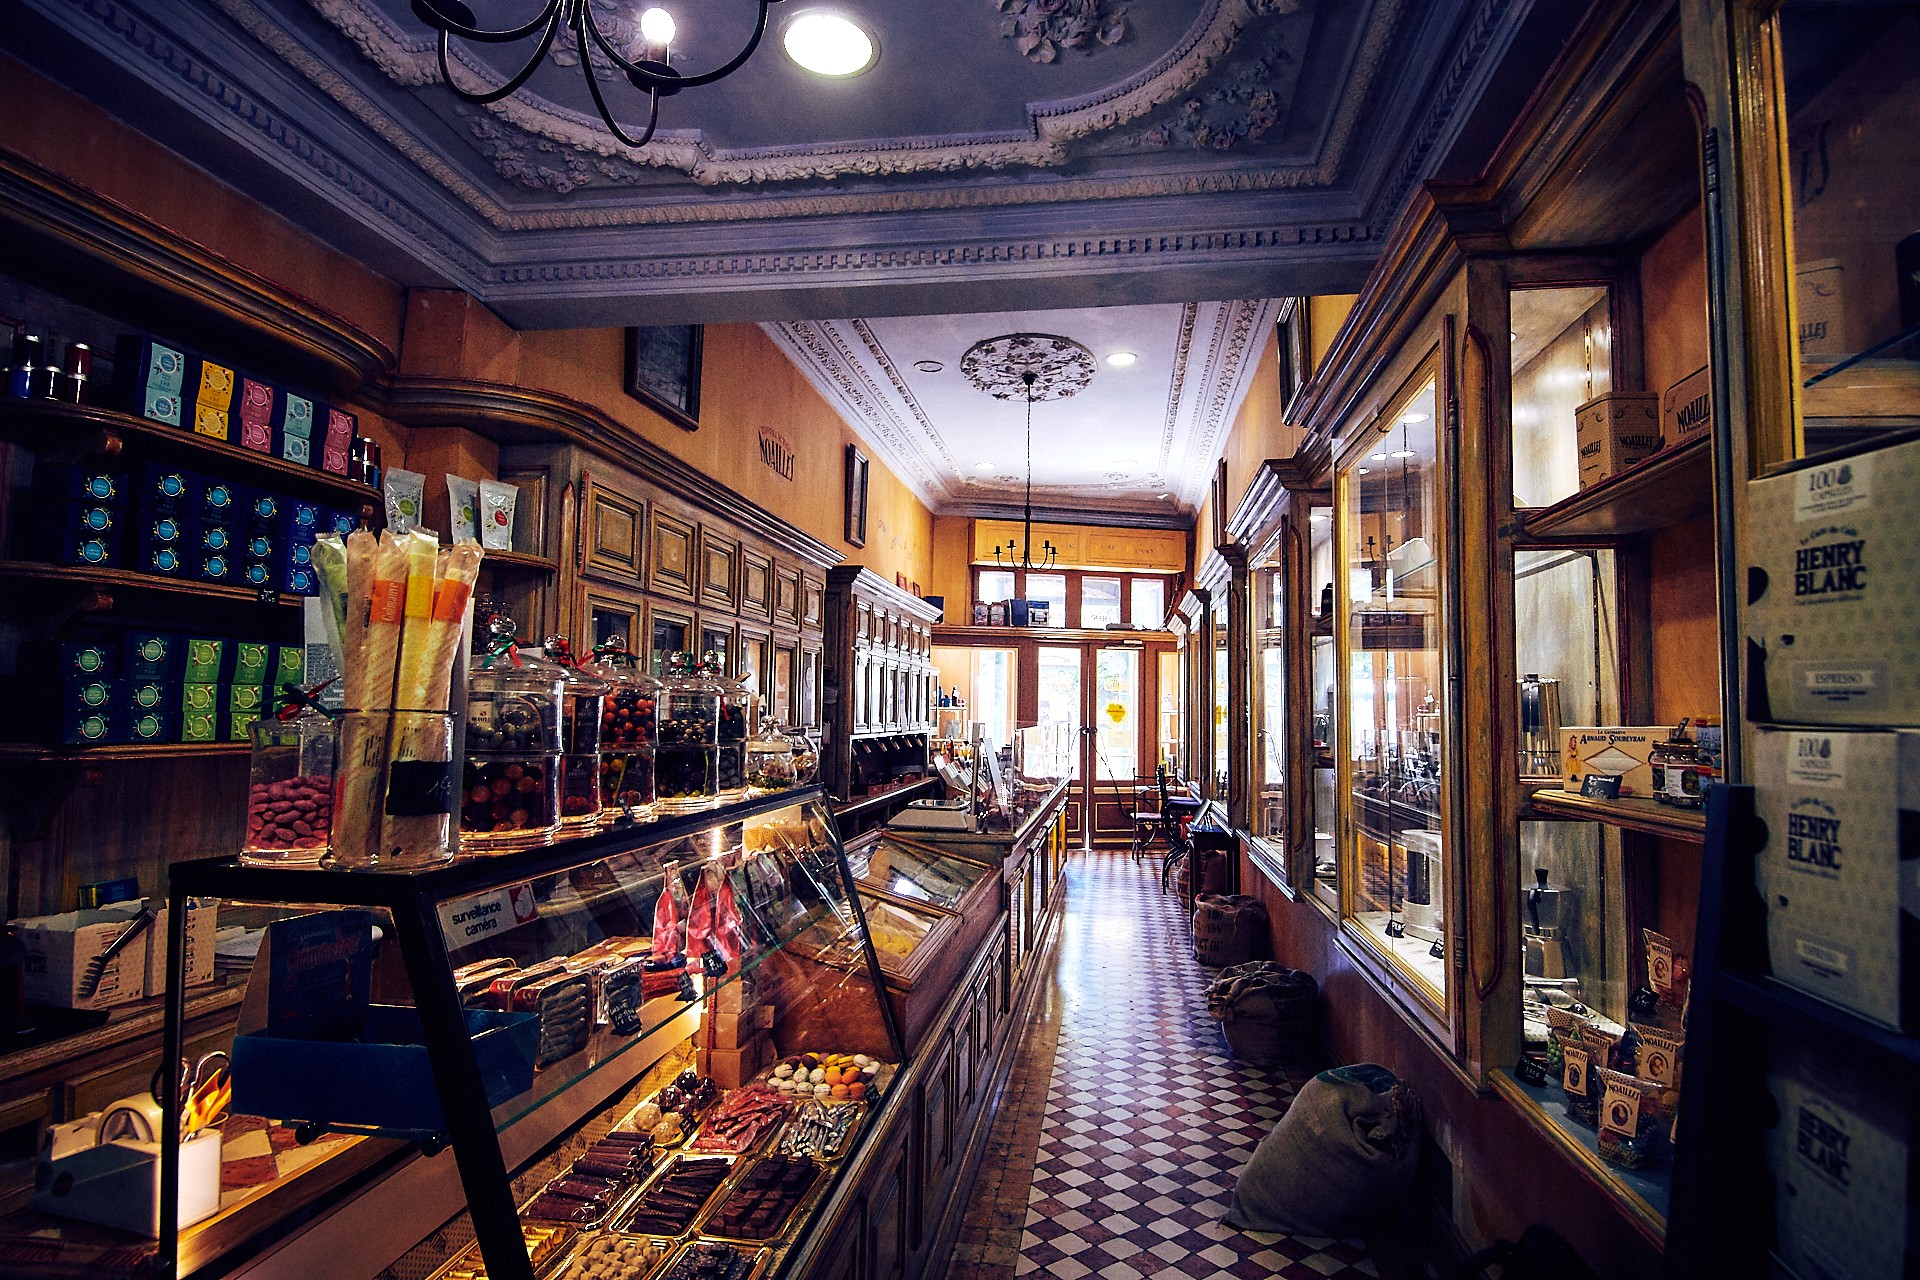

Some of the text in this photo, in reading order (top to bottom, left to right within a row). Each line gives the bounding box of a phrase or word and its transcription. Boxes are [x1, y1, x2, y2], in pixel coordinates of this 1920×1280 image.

[1580, 440, 1602, 458] NOAILLES
[1620, 434, 1654, 448] NOAILLES
[1796, 539, 1867, 572] HENRY
[1795, 565, 1867, 596] BLANC
[1580, 734, 1646, 745] ARNAUD SOUBEYRAN
[1789, 813, 1842, 842] HENRY
[1788, 837, 1842, 870] BLANC
[452, 902, 501, 925] surveillance
[465, 918, 498, 936] caméra
[1584, 1035, 1608, 1049] NOAILLES
[1643, 1036, 1675, 1052] NOAILLES
[1565, 1049, 1588, 1062] NOAILLES
[1608, 1083, 1640, 1101] NOAILLES
